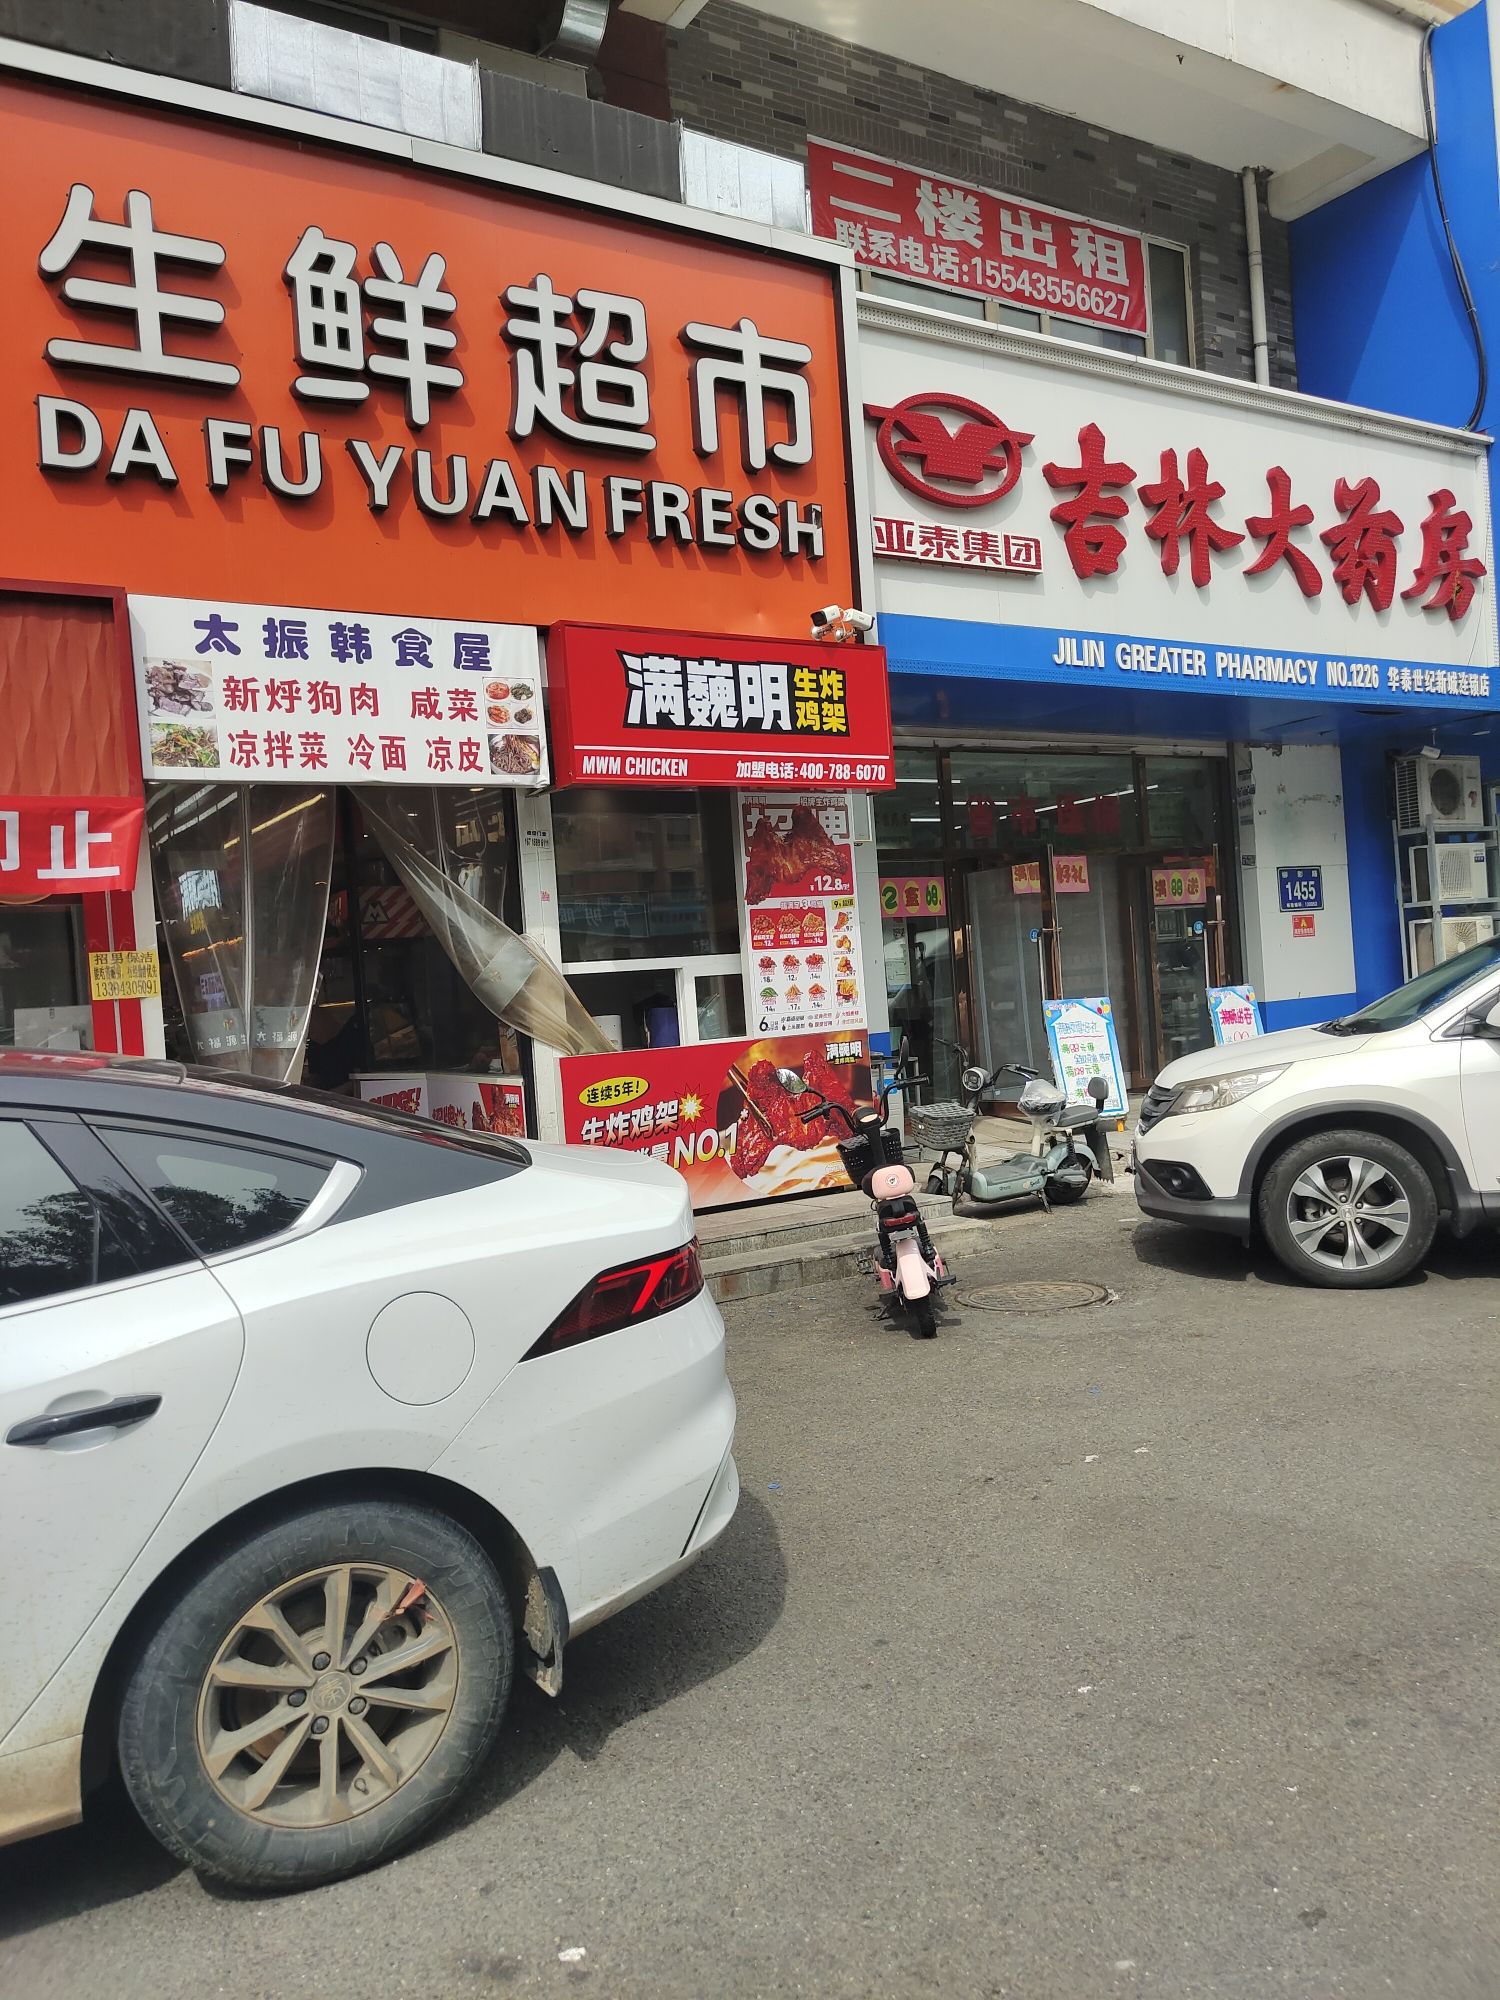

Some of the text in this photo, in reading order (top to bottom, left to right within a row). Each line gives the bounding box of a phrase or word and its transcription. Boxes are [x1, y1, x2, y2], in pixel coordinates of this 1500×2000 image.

[829, 161, 1130, 287] 二楼出租
[833, 217, 1130, 322] 联系电话:15543556627
[37, 182, 815, 473] 生鲜超市
[36, 394, 825, 561] DA FU YUAN FRESH
[873, 516, 1043, 570] 亚泰集团
[1042, 421, 1487, 622] 吉林大药房
[193, 613, 494, 672] 太振韩食屋
[1052, 636, 1490, 697] JILIN GREATER PHARMACY NO.1226 华泰世纪新城连锁店
[222, 675, 480, 722] 新烀狗肉 咸菜
[622, 654, 845, 732] 满巍明 生炸
[795, 700, 848, 733] 鸡架
[227, 729, 485, 773] 凉拌菜 冷面 凉皮
[582, 755, 688, 778] MWM CHICKEN
[735, 760, 887, 782] 加盟电话:400-788-6070
[1285, 880, 1316, 901] 1455
[586, 1080, 641, 1104] 连续5年!
[580, 1099, 679, 1145] 生炸鸡架
[673, 1122, 739, 1169] NO.1
